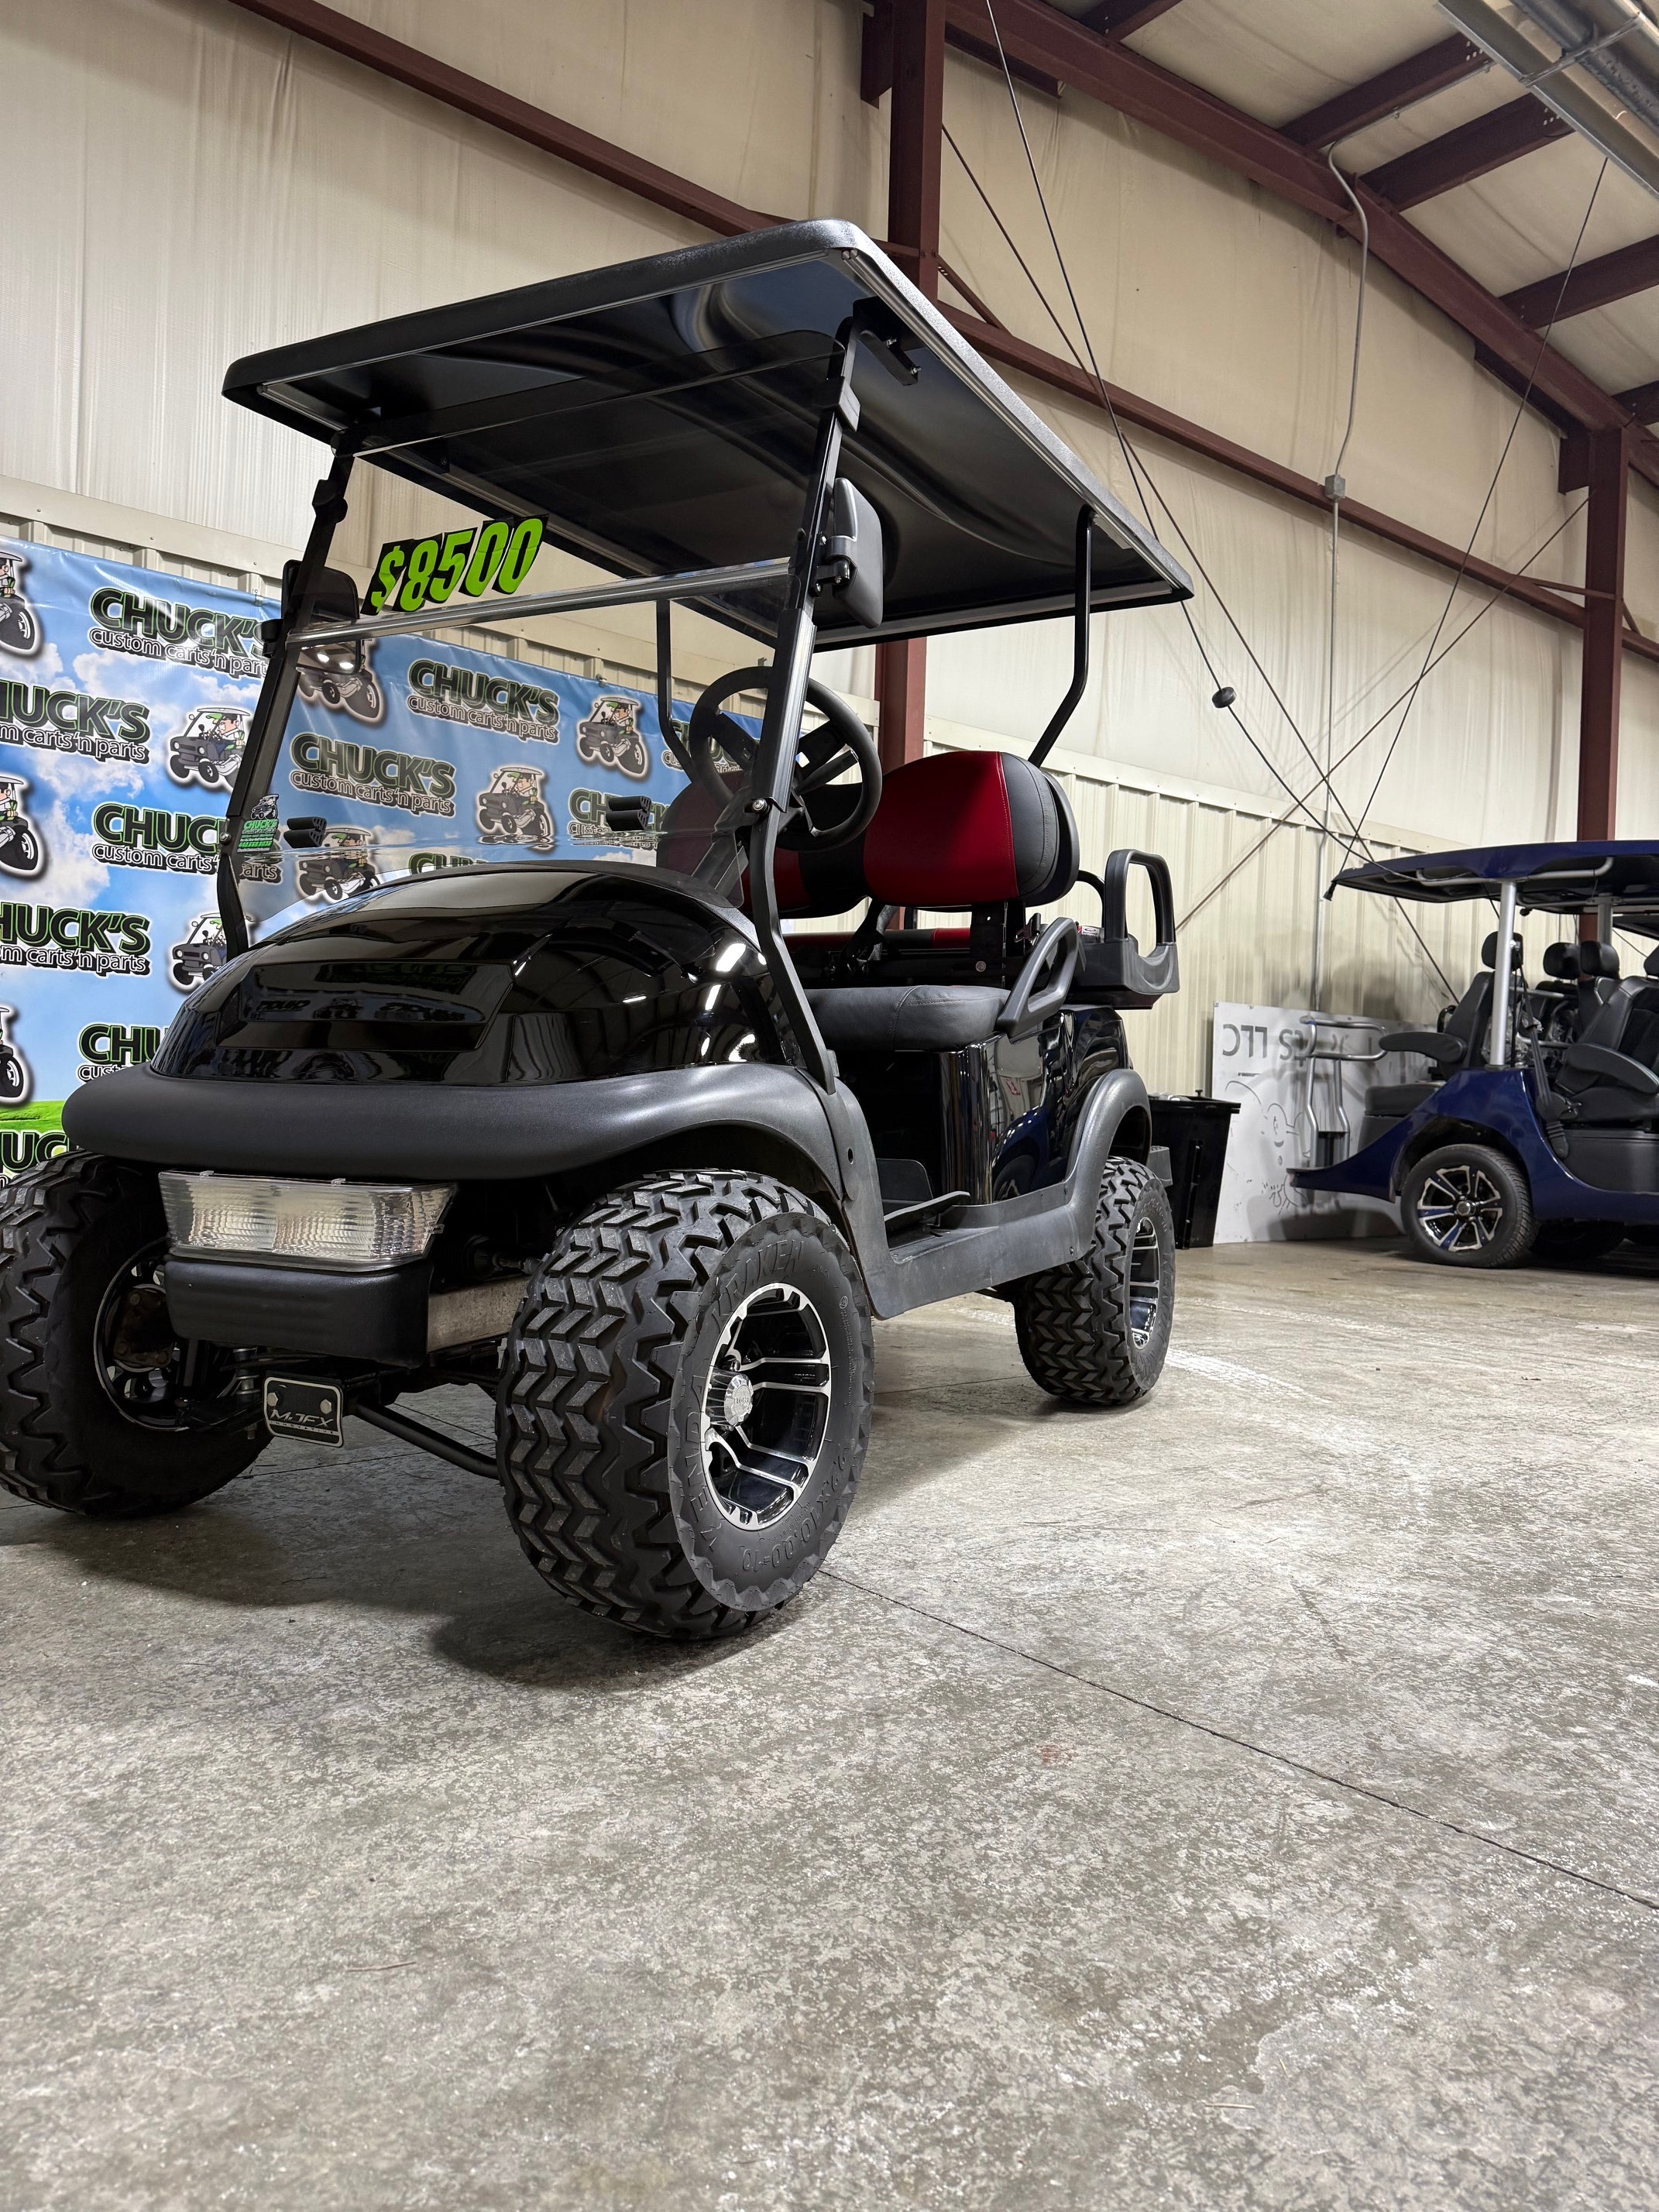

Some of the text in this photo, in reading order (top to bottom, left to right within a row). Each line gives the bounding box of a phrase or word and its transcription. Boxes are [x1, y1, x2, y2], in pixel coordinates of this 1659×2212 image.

[371, 518, 542, 613] $8500
[90, 629, 161, 656] custom
[165, 644, 211, 666] carts
[229, 655, 268, 675] part
[409, 660, 558, 725] CHUCK'S
[407, 695, 465, 721] custom
[468, 709, 503, 729] carts
[519, 720, 556, 740] parts
[22, 727, 73, 750] carts
[95, 738, 147, 762] parts
[291, 733, 456, 799] CHUCK'S
[290, 771, 352, 795] custom
[356, 783, 395, 803] carts
[411, 793, 452, 813] parts
[94, 803, 226, 854] CHUC
[92, 843, 163, 867] custom
[166, 853, 212, 872] carts
[26, 946, 73, 967] carts
[96, 953, 147, 974] parts
[686, 1373, 721, 1552] KENDA
